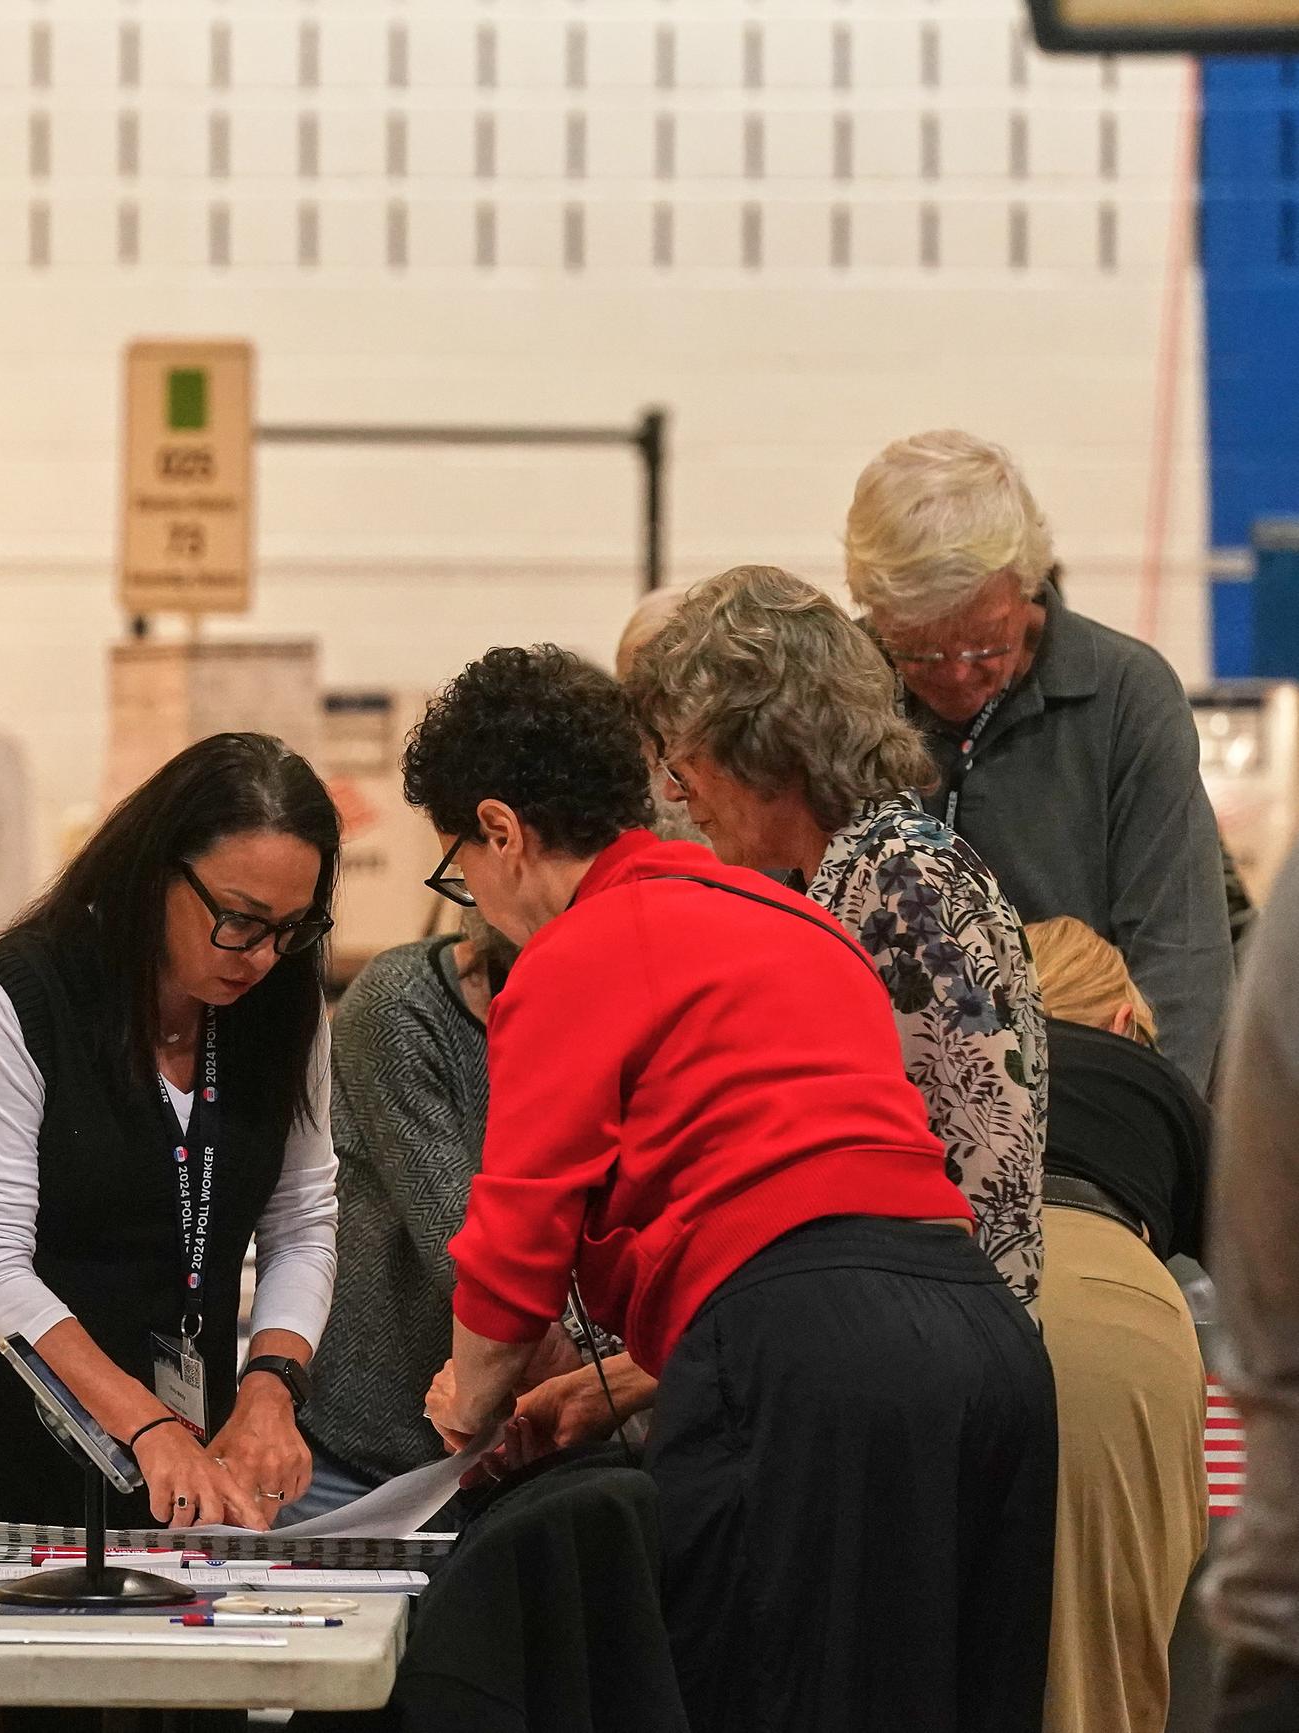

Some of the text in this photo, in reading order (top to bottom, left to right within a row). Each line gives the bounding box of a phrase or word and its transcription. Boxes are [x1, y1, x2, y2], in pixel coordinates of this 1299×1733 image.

[207, 1019, 216, 1048] POLL
[206, 1052, 217, 1083] 2024
[178, 1166, 190, 1198] 2024
[181, 1200, 192, 1230] POLL
[191, 1146, 214, 1269] 2024 POLL WORKER
